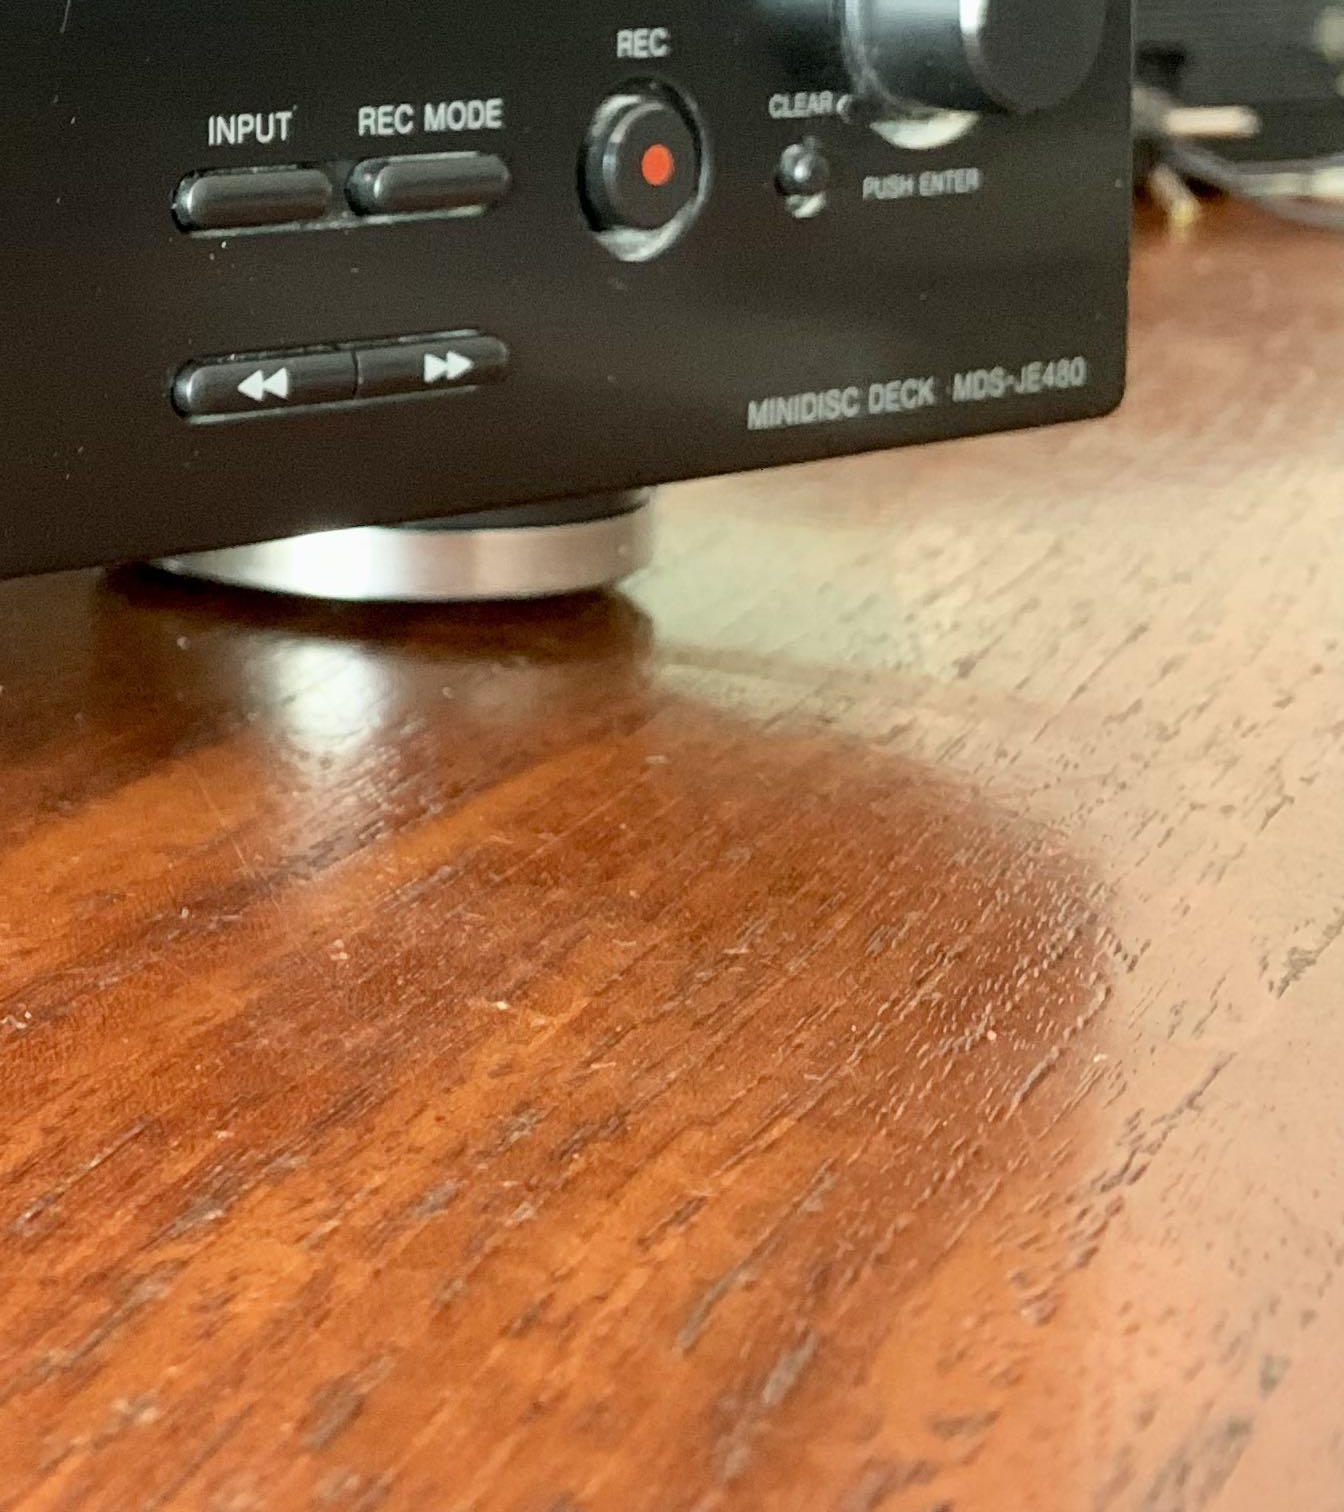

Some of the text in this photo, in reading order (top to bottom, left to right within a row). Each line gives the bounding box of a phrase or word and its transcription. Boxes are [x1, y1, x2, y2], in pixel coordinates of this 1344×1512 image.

[617, 29, 670, 58] REC
[358, 99, 503, 136] REC MODE
[769, 92, 833, 119] CLEAR
[208, 111, 293, 146] INPUT
[747, 385, 861, 430] MINIDISC
[868, 376, 936, 414] DECK
